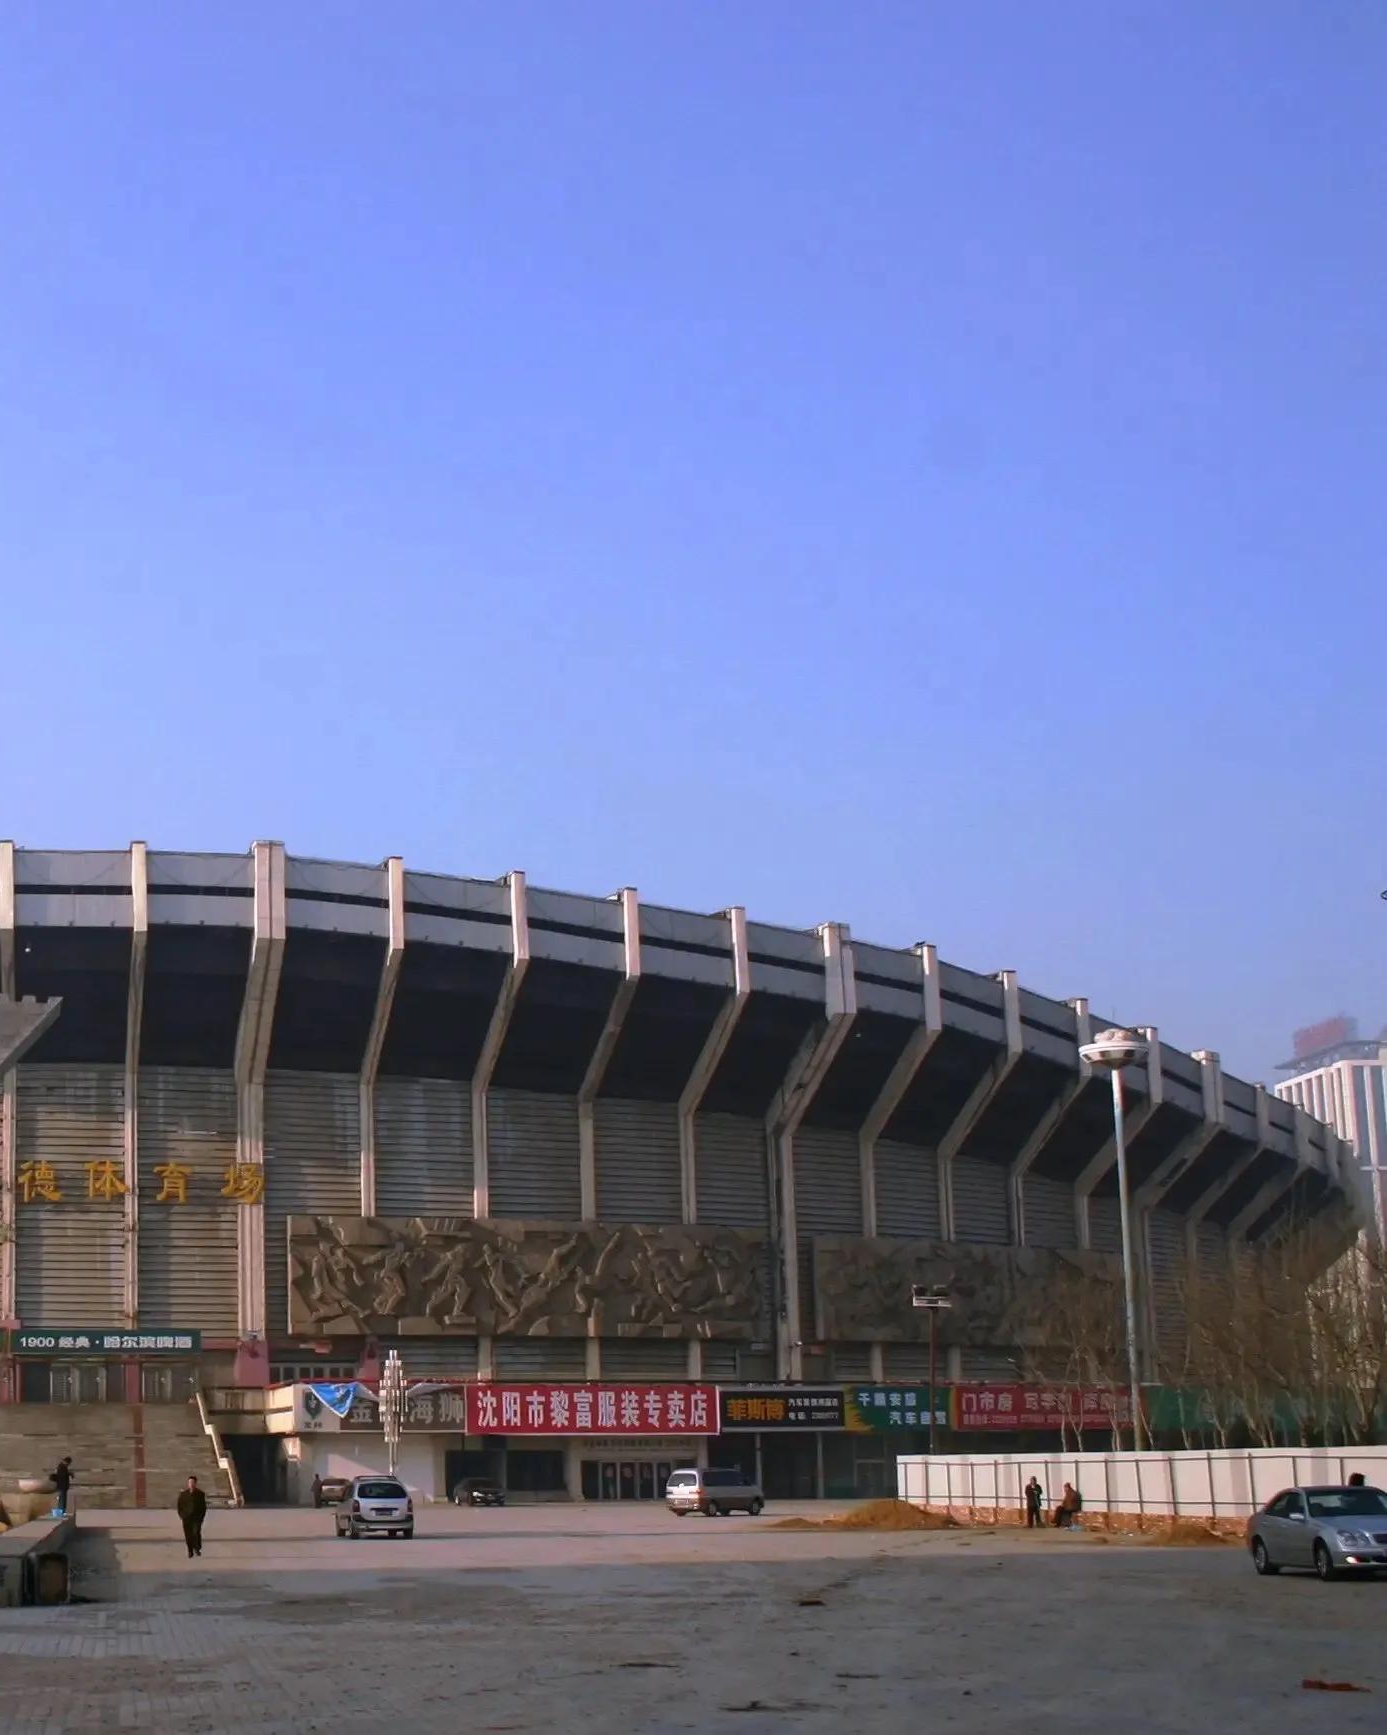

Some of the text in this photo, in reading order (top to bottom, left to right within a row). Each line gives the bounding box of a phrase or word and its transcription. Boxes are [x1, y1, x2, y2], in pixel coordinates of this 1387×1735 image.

[20, 1336, 55, 1348] 1900
[349, 1391, 464, 1425] 金海狮
[477, 1390, 708, 1429] 沈阳市黎富服装专卖店
